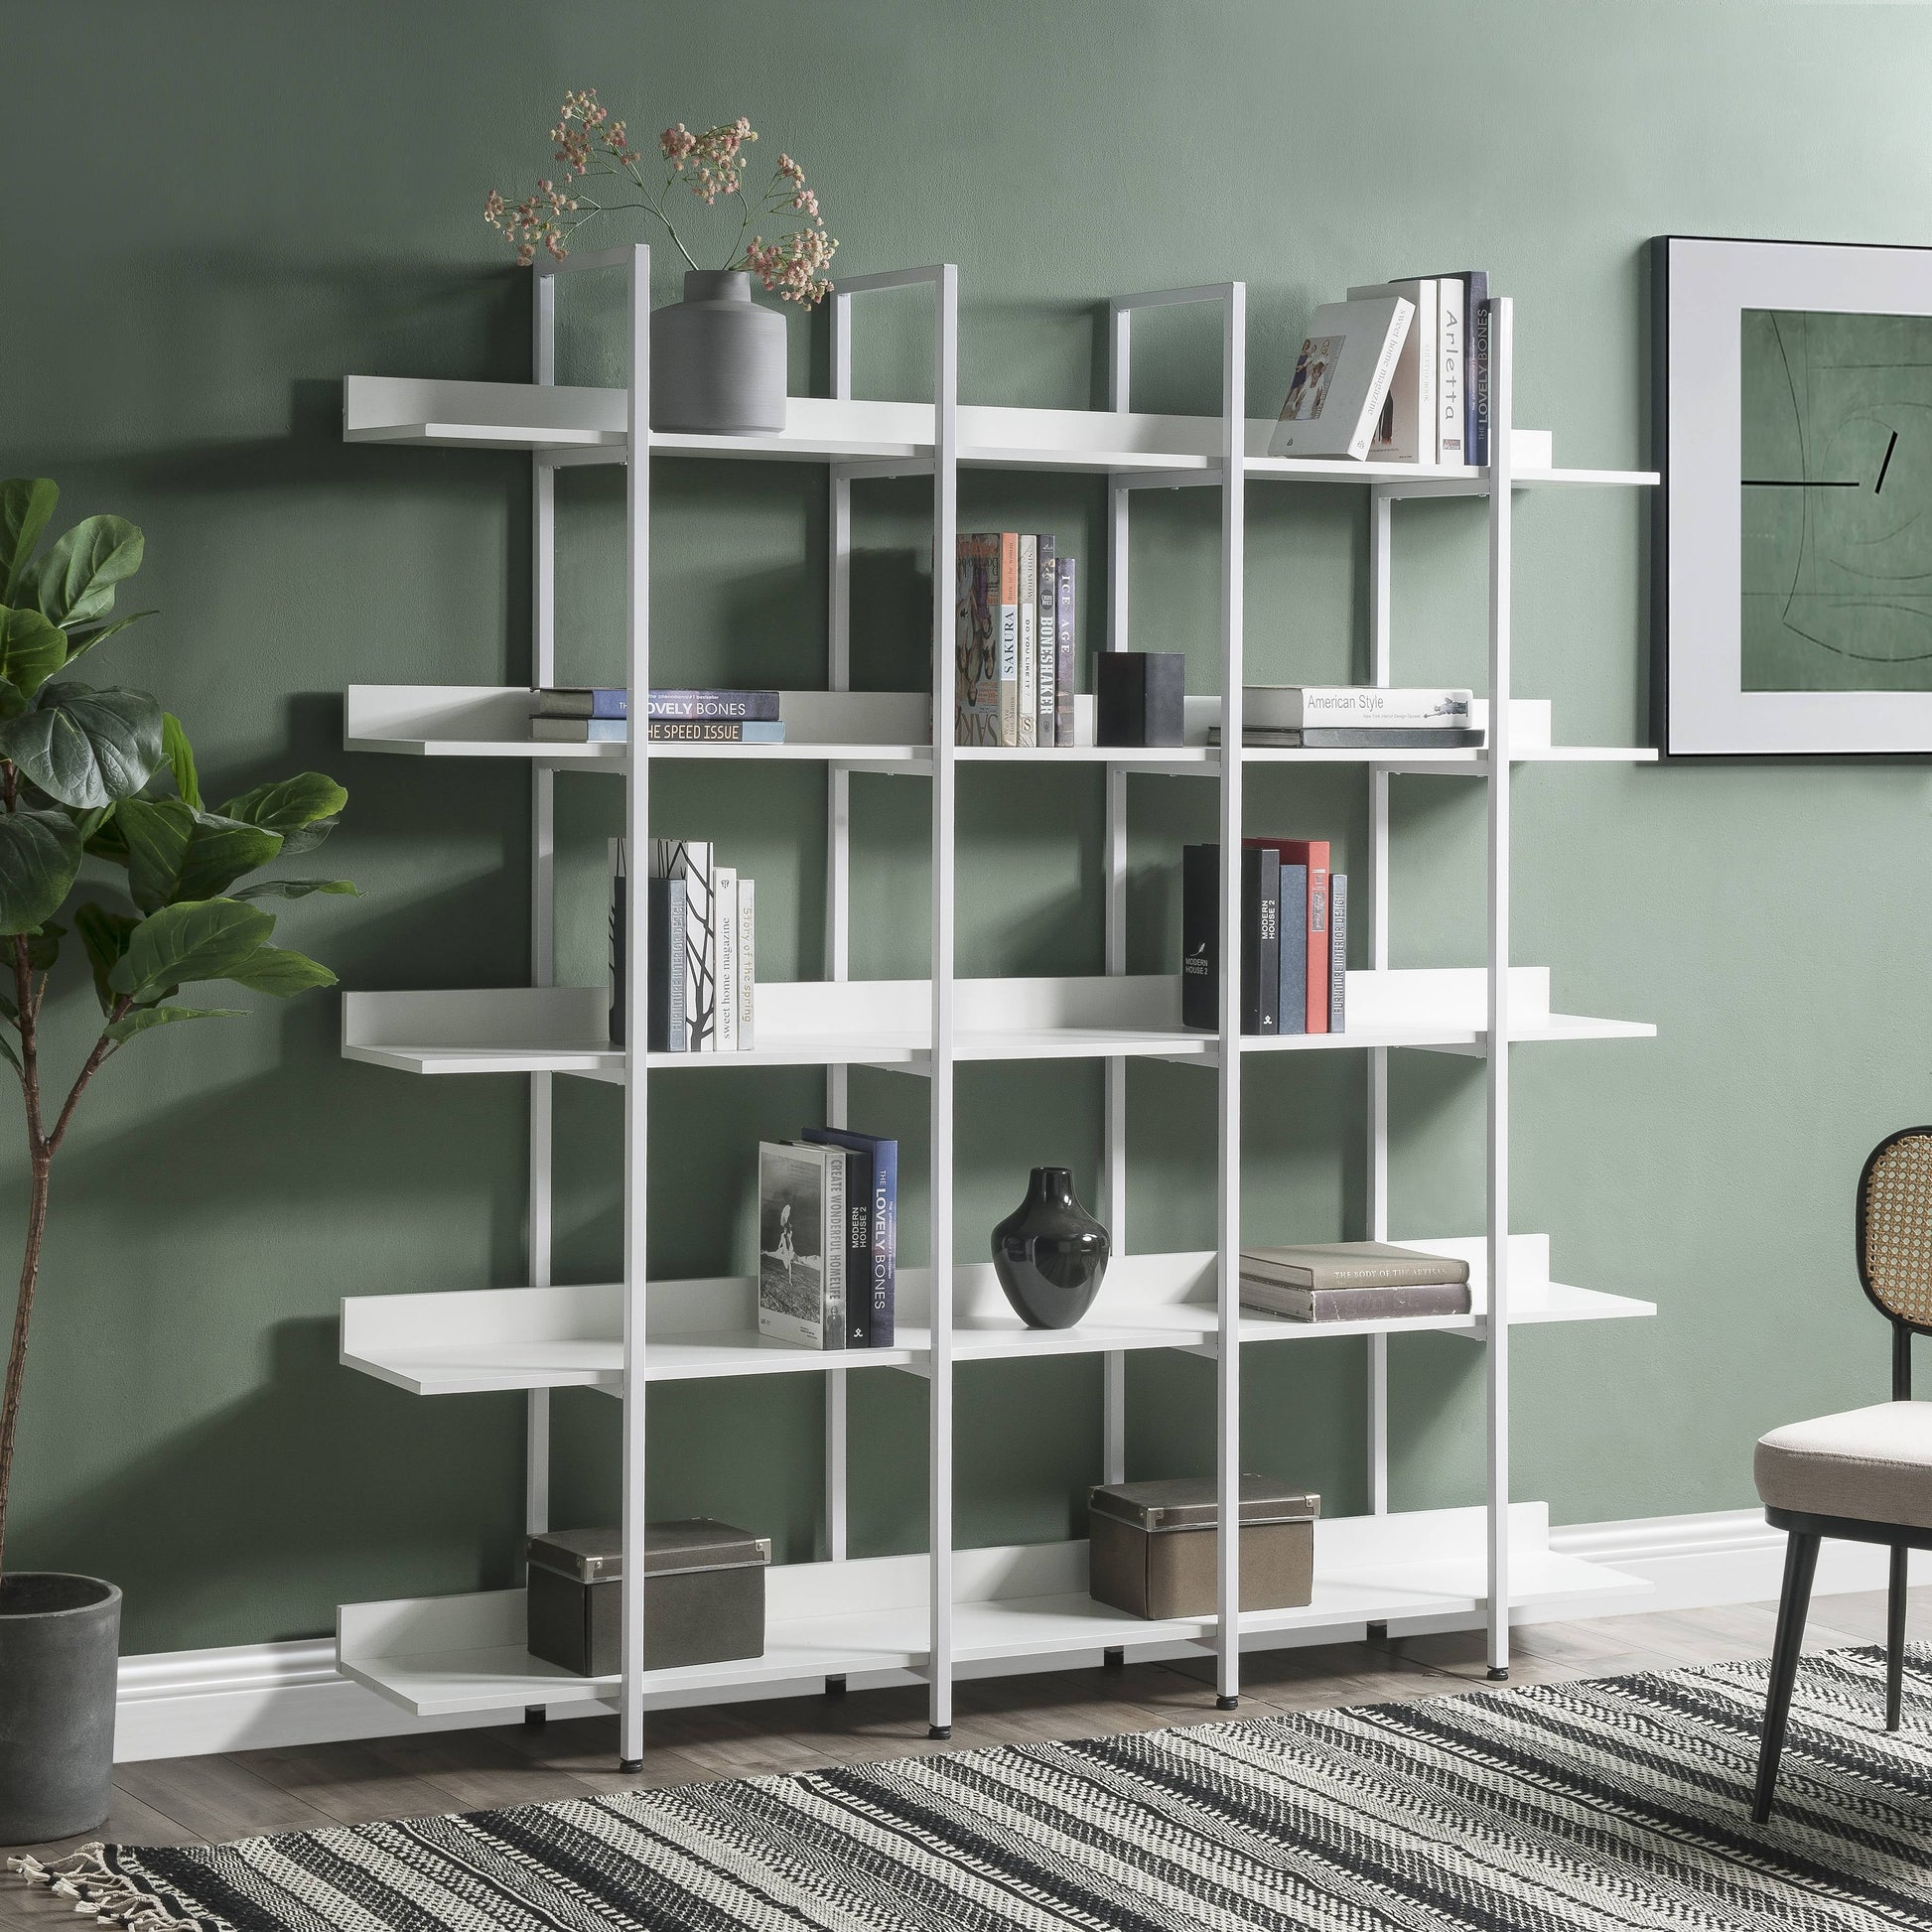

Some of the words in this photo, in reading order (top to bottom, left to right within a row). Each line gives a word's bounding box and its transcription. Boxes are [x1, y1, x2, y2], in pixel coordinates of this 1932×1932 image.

[1477, 309, 1487, 357] BONES
[1445, 310, 1458, 420] Arletta
[1478, 364, 1487, 423] LOVELY
[1061, 576, 1070, 605] ICE
[1004, 612, 1015, 674] SAKURA
[1061, 619, 1070, 653] AGE
[1040, 617, 1053, 715] BONESHAKER
[648, 702, 692, 715] OVELY
[696, 702, 746, 715] BONES
[1308, 694, 1356, 709] American
[1358, 694, 1384, 712] Style
[648, 724, 661, 738] HE
[664, 724, 701, 739] SPEED
[703, 725, 740, 740] ISSUE
[741, 907, 753, 940] Story
[1334, 893, 1345, 925] DESIGN
[721, 917, 733, 971] magazine
[744, 944, 753, 957] of
[1185, 958, 1208, 967] MODERN
[1334, 927, 1345, 966] INTERIOR
[722, 974, 731, 1006] home
[744, 962, 753, 982] the
[742, 985, 753, 1023] spring
[1333, 968, 1345, 1015] FURNITURE
[830, 1160, 843, 1192] CREATE
[830, 1194, 843, 1252] WONDERFUL
[875, 1188, 887, 1251] LOVELY
[829, 1255, 842, 1300] HOMELIFE
[874, 1255, 886, 1310] BONES
